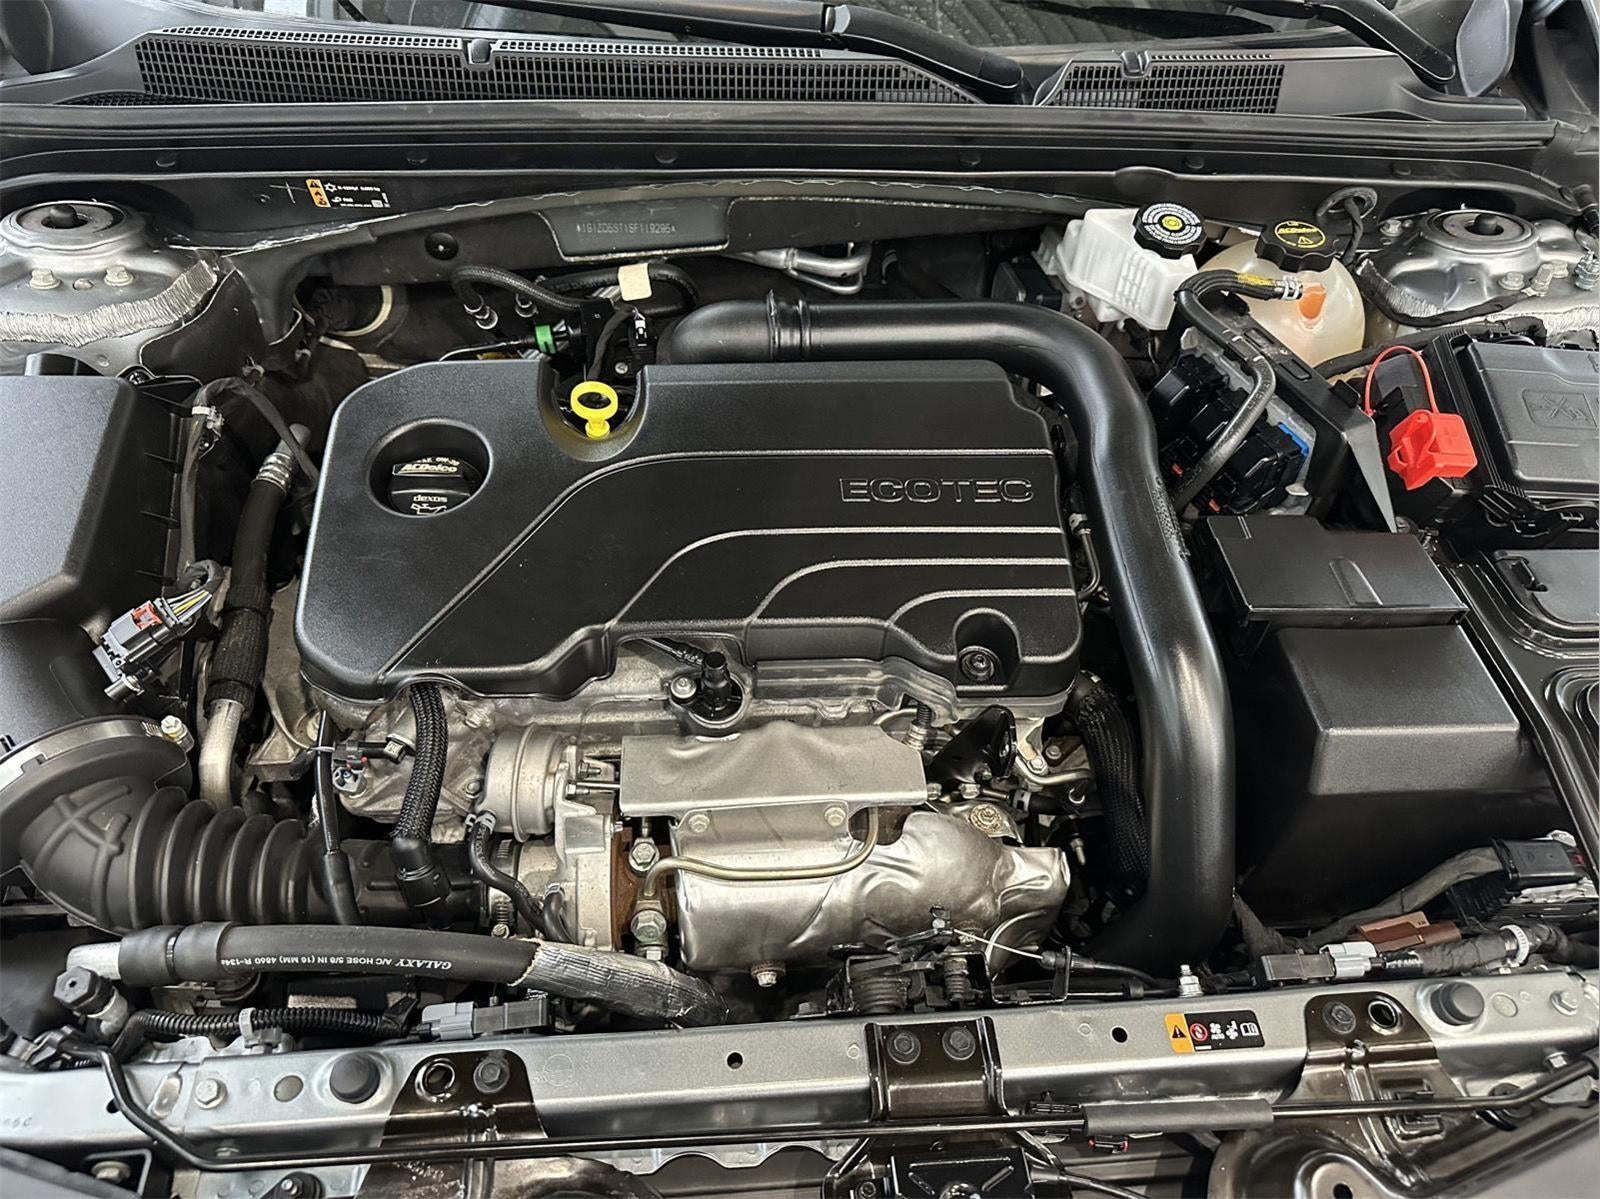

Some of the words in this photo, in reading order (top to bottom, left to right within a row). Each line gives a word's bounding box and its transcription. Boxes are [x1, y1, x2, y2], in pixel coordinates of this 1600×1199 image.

[401, 463, 457, 472] ACDelco
[839, 477, 1034, 502] ECOTEC
[413, 495, 448, 503] dexos
[279, 955, 299, 964] MM)
[300, 955, 315, 965] (16
[317, 956, 328, 964] IN
[329, 956, 344, 965] 5/8
[345, 956, 374, 965] HOSE
[375, 957, 392, 966] A/C
[394, 958, 452, 970] GALAXY
